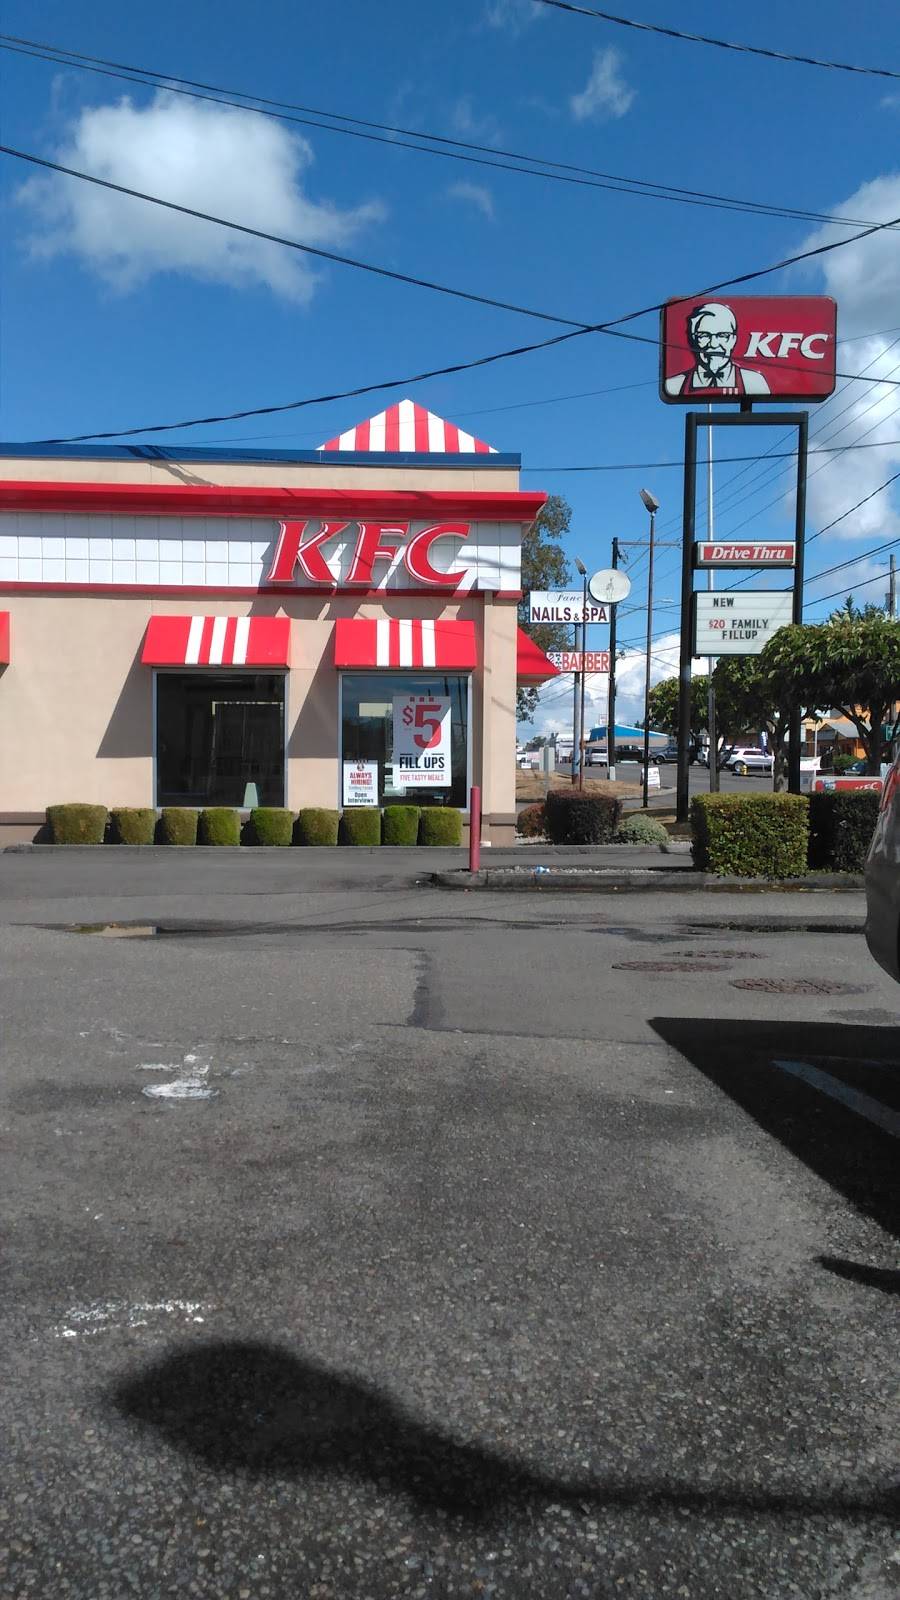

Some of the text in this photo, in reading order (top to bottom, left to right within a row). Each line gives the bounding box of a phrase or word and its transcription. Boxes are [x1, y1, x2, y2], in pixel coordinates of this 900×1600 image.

[743, 331, 829, 359] KFC
[266, 520, 471, 585] KFC
[711, 546, 786, 559] Drive Thru
[713, 598, 734, 607] NEW
[531, 606, 608, 622] NAILS & SPA
[709, 619, 769, 629] $20 FAMILY
[722, 630, 758, 640] FILLUP
[402, 704, 442, 749] $5
[399, 756, 445, 769] FILL UPS
